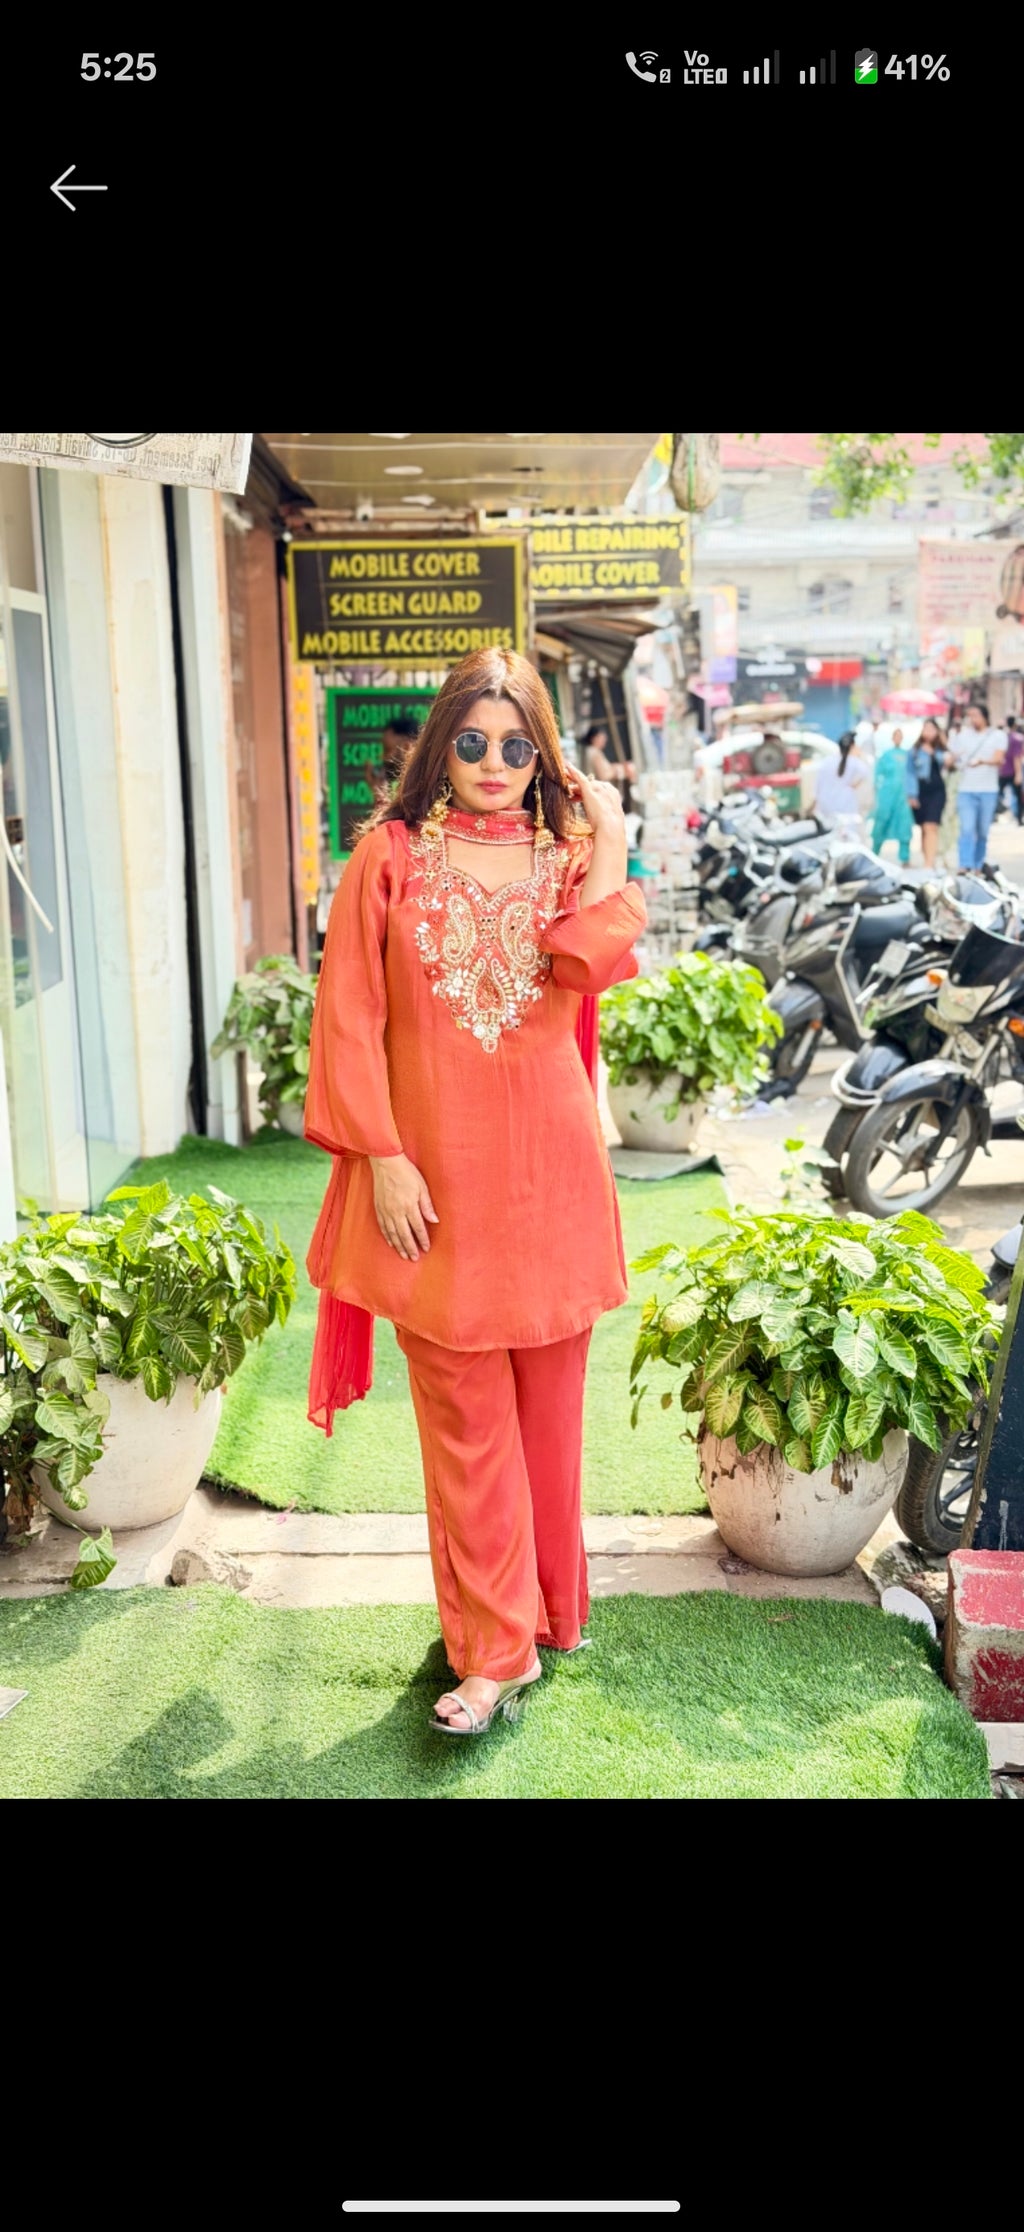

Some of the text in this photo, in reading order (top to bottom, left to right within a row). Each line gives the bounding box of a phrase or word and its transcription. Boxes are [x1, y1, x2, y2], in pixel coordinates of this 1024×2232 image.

[532, 525, 680, 553] BILE REPAIRING
[329, 552, 481, 578] MOBILE COVER
[595, 561, 661, 586] COVER
[329, 590, 482, 617] SCREEN GUARD
[302, 627, 513, 654] MOBILE ACCESSORIES
